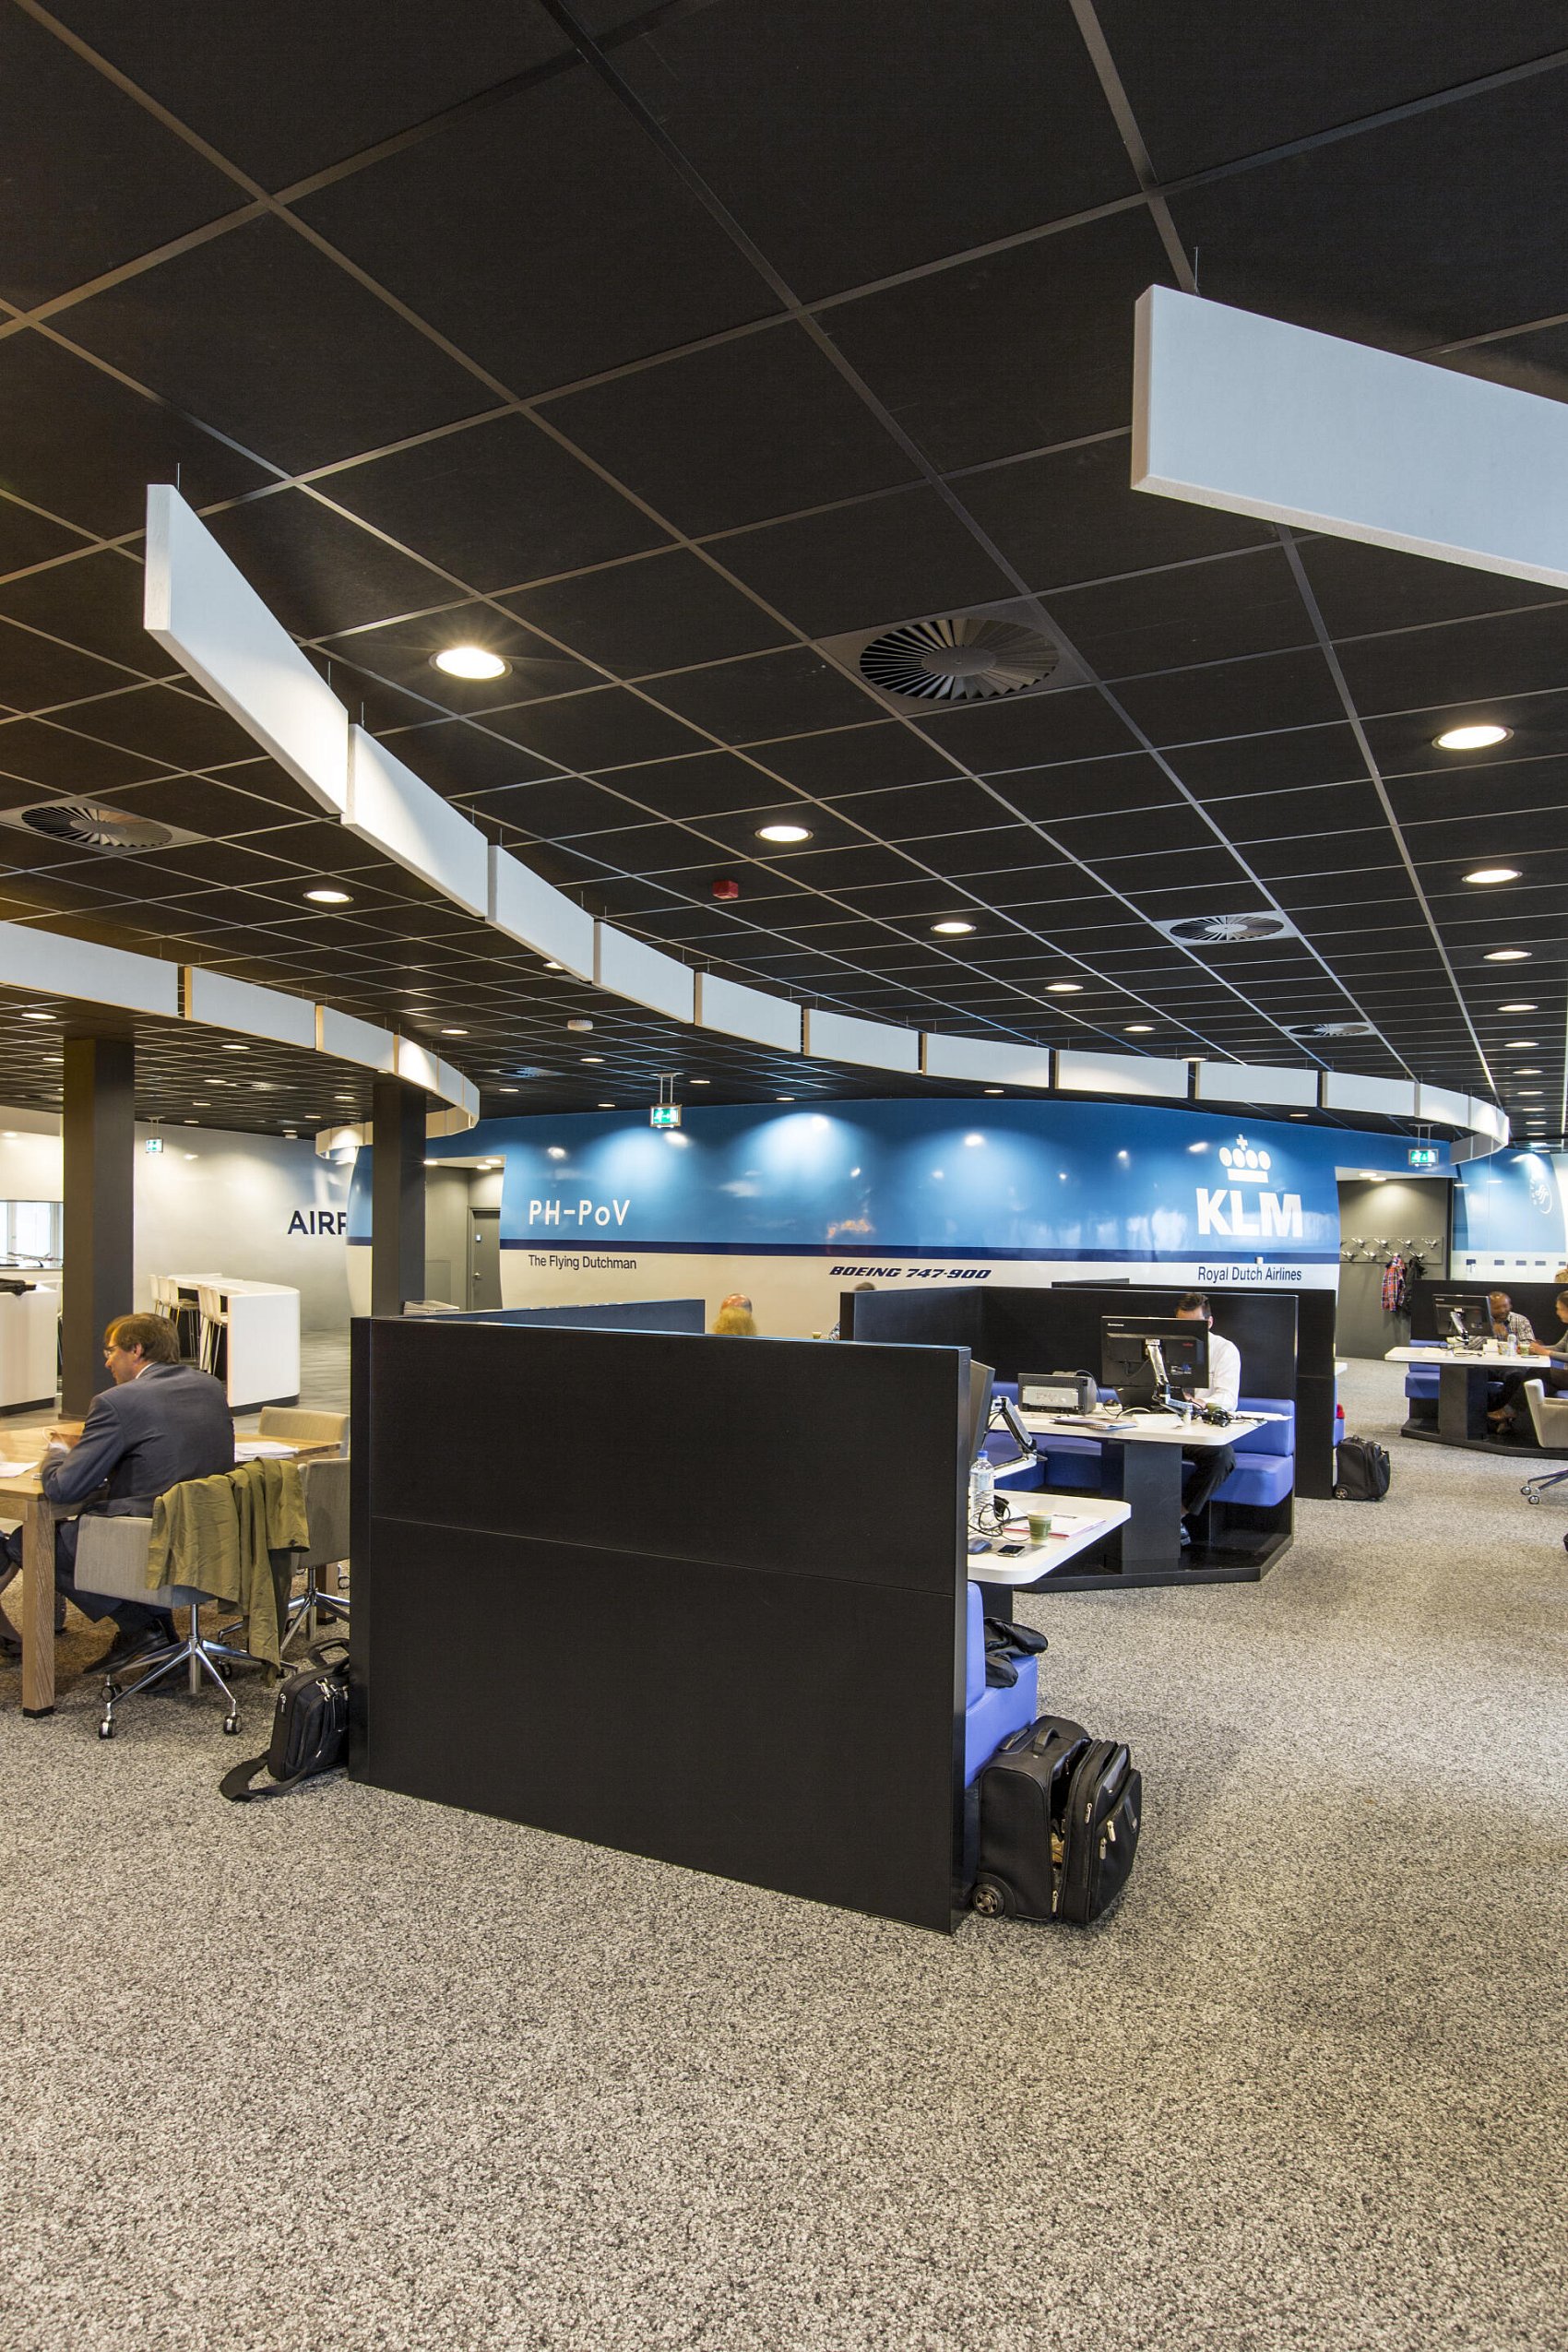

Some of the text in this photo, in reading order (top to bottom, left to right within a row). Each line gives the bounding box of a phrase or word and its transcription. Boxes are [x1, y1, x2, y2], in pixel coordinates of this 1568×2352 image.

[529, 1199, 631, 1227] PH-PoV
[1195, 1187, 1303, 1238] KLM
[528, 1254, 637, 1271] The Flying Dutchman
[829, 1266, 992, 1279] BOEING 747-900
[1198, 1266, 1302, 1283] Royal Dutch Airlines
